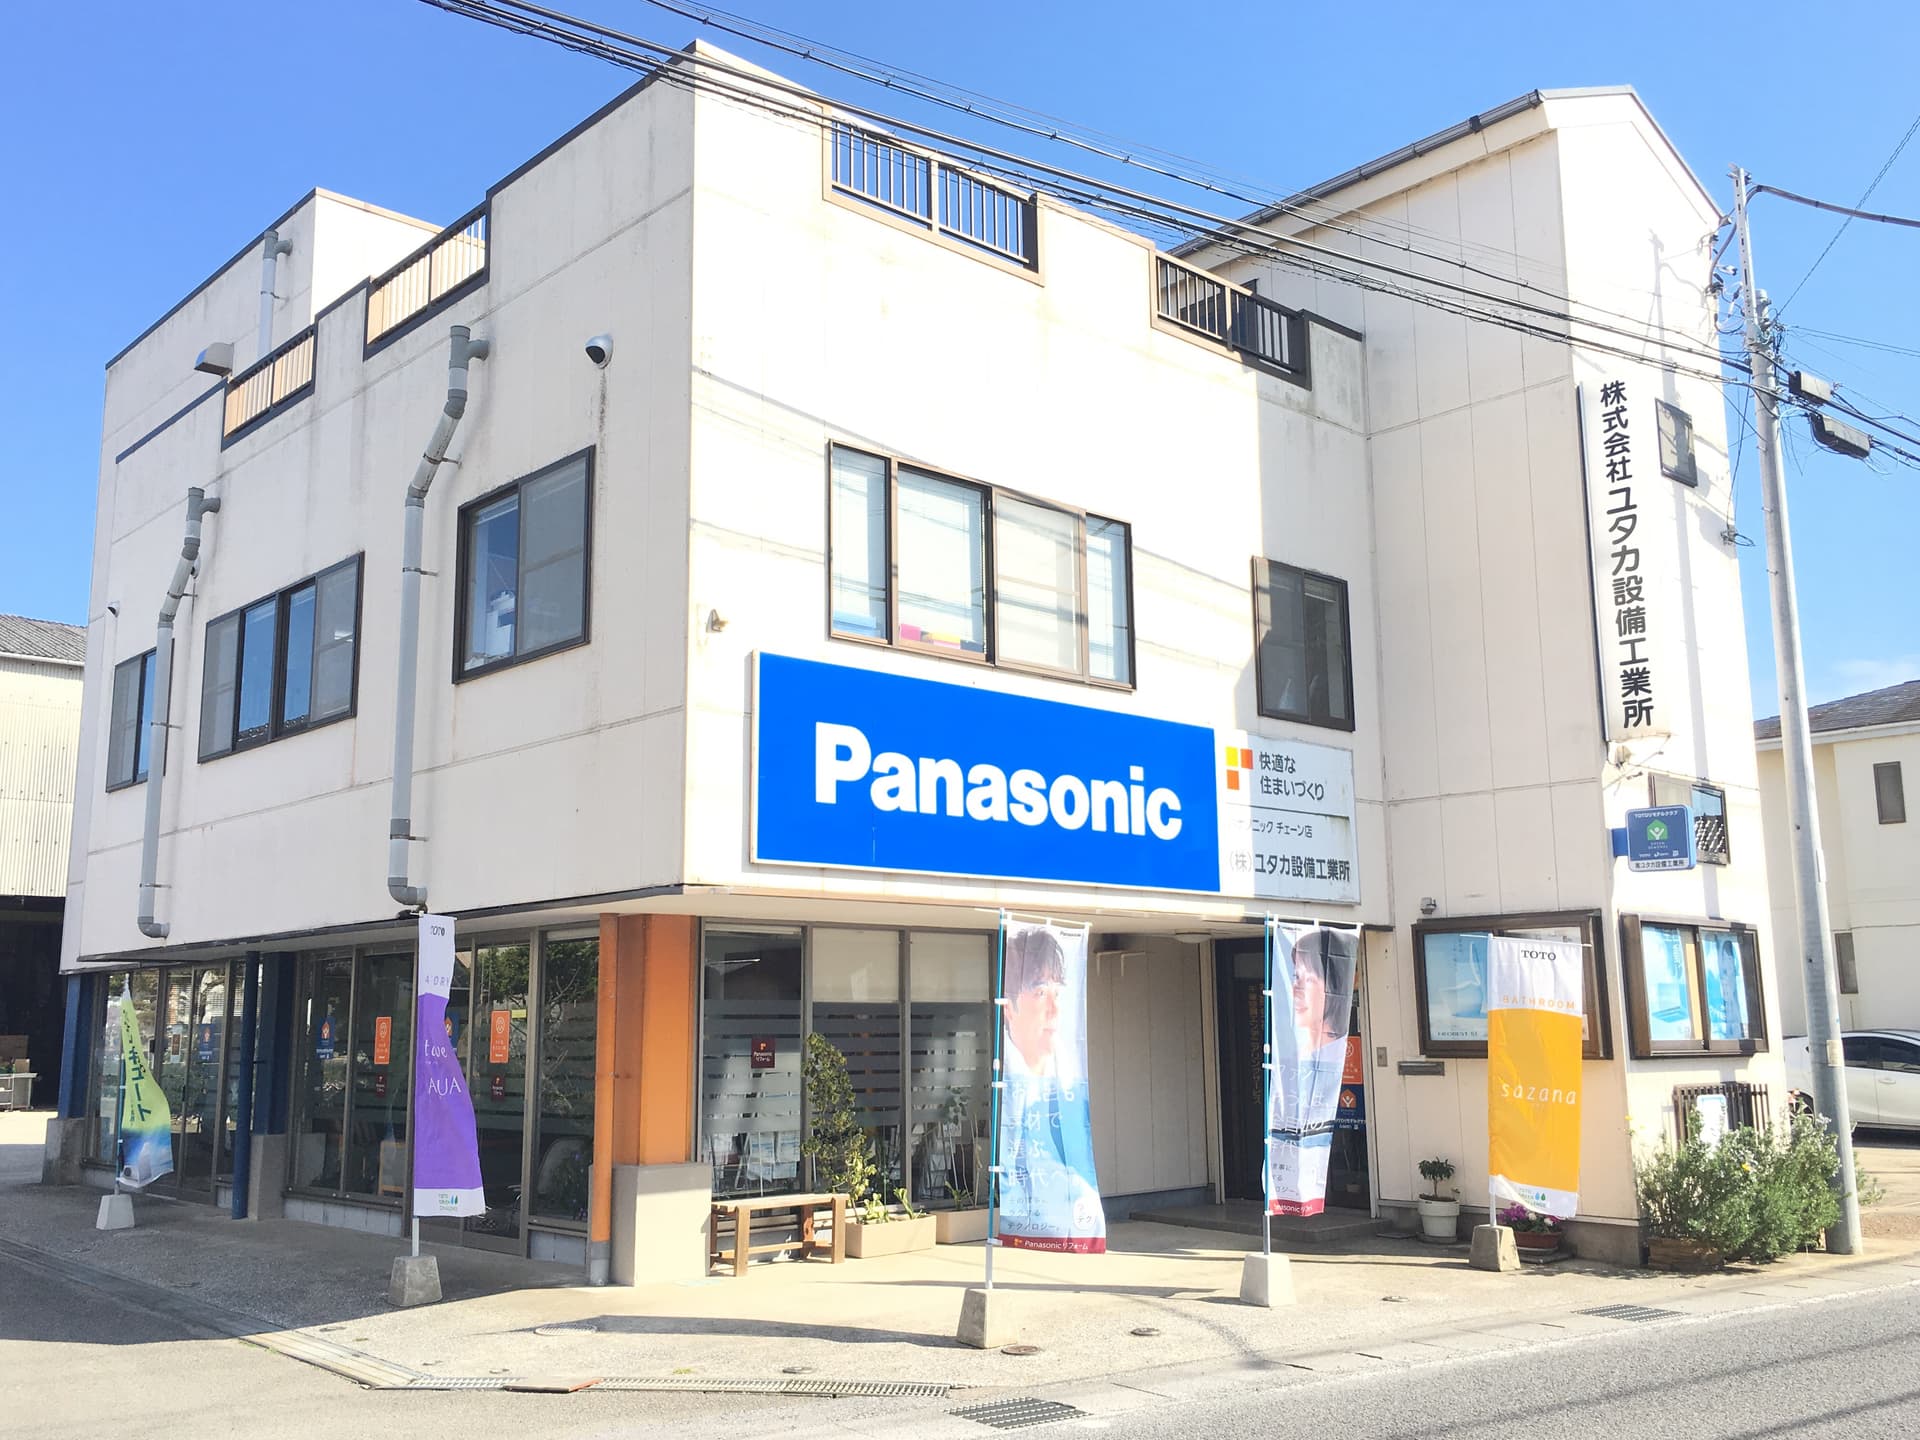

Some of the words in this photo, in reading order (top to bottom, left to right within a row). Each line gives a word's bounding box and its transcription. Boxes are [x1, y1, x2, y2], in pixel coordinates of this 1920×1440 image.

[1600, 380, 1654, 729] 株式会社ユタカ設備工業所
[1259, 751, 1296, 774] 快適な
[815, 721, 1183, 841] Panasonic
[1260, 776, 1325, 801] 住まいづくり
[1521, 949, 1557, 960] TOTO
[1503, 995, 1576, 1009] BATHROOM
[1501, 1083, 1576, 1105] sazana
[1025, 1240, 1062, 1249] Panasonic
